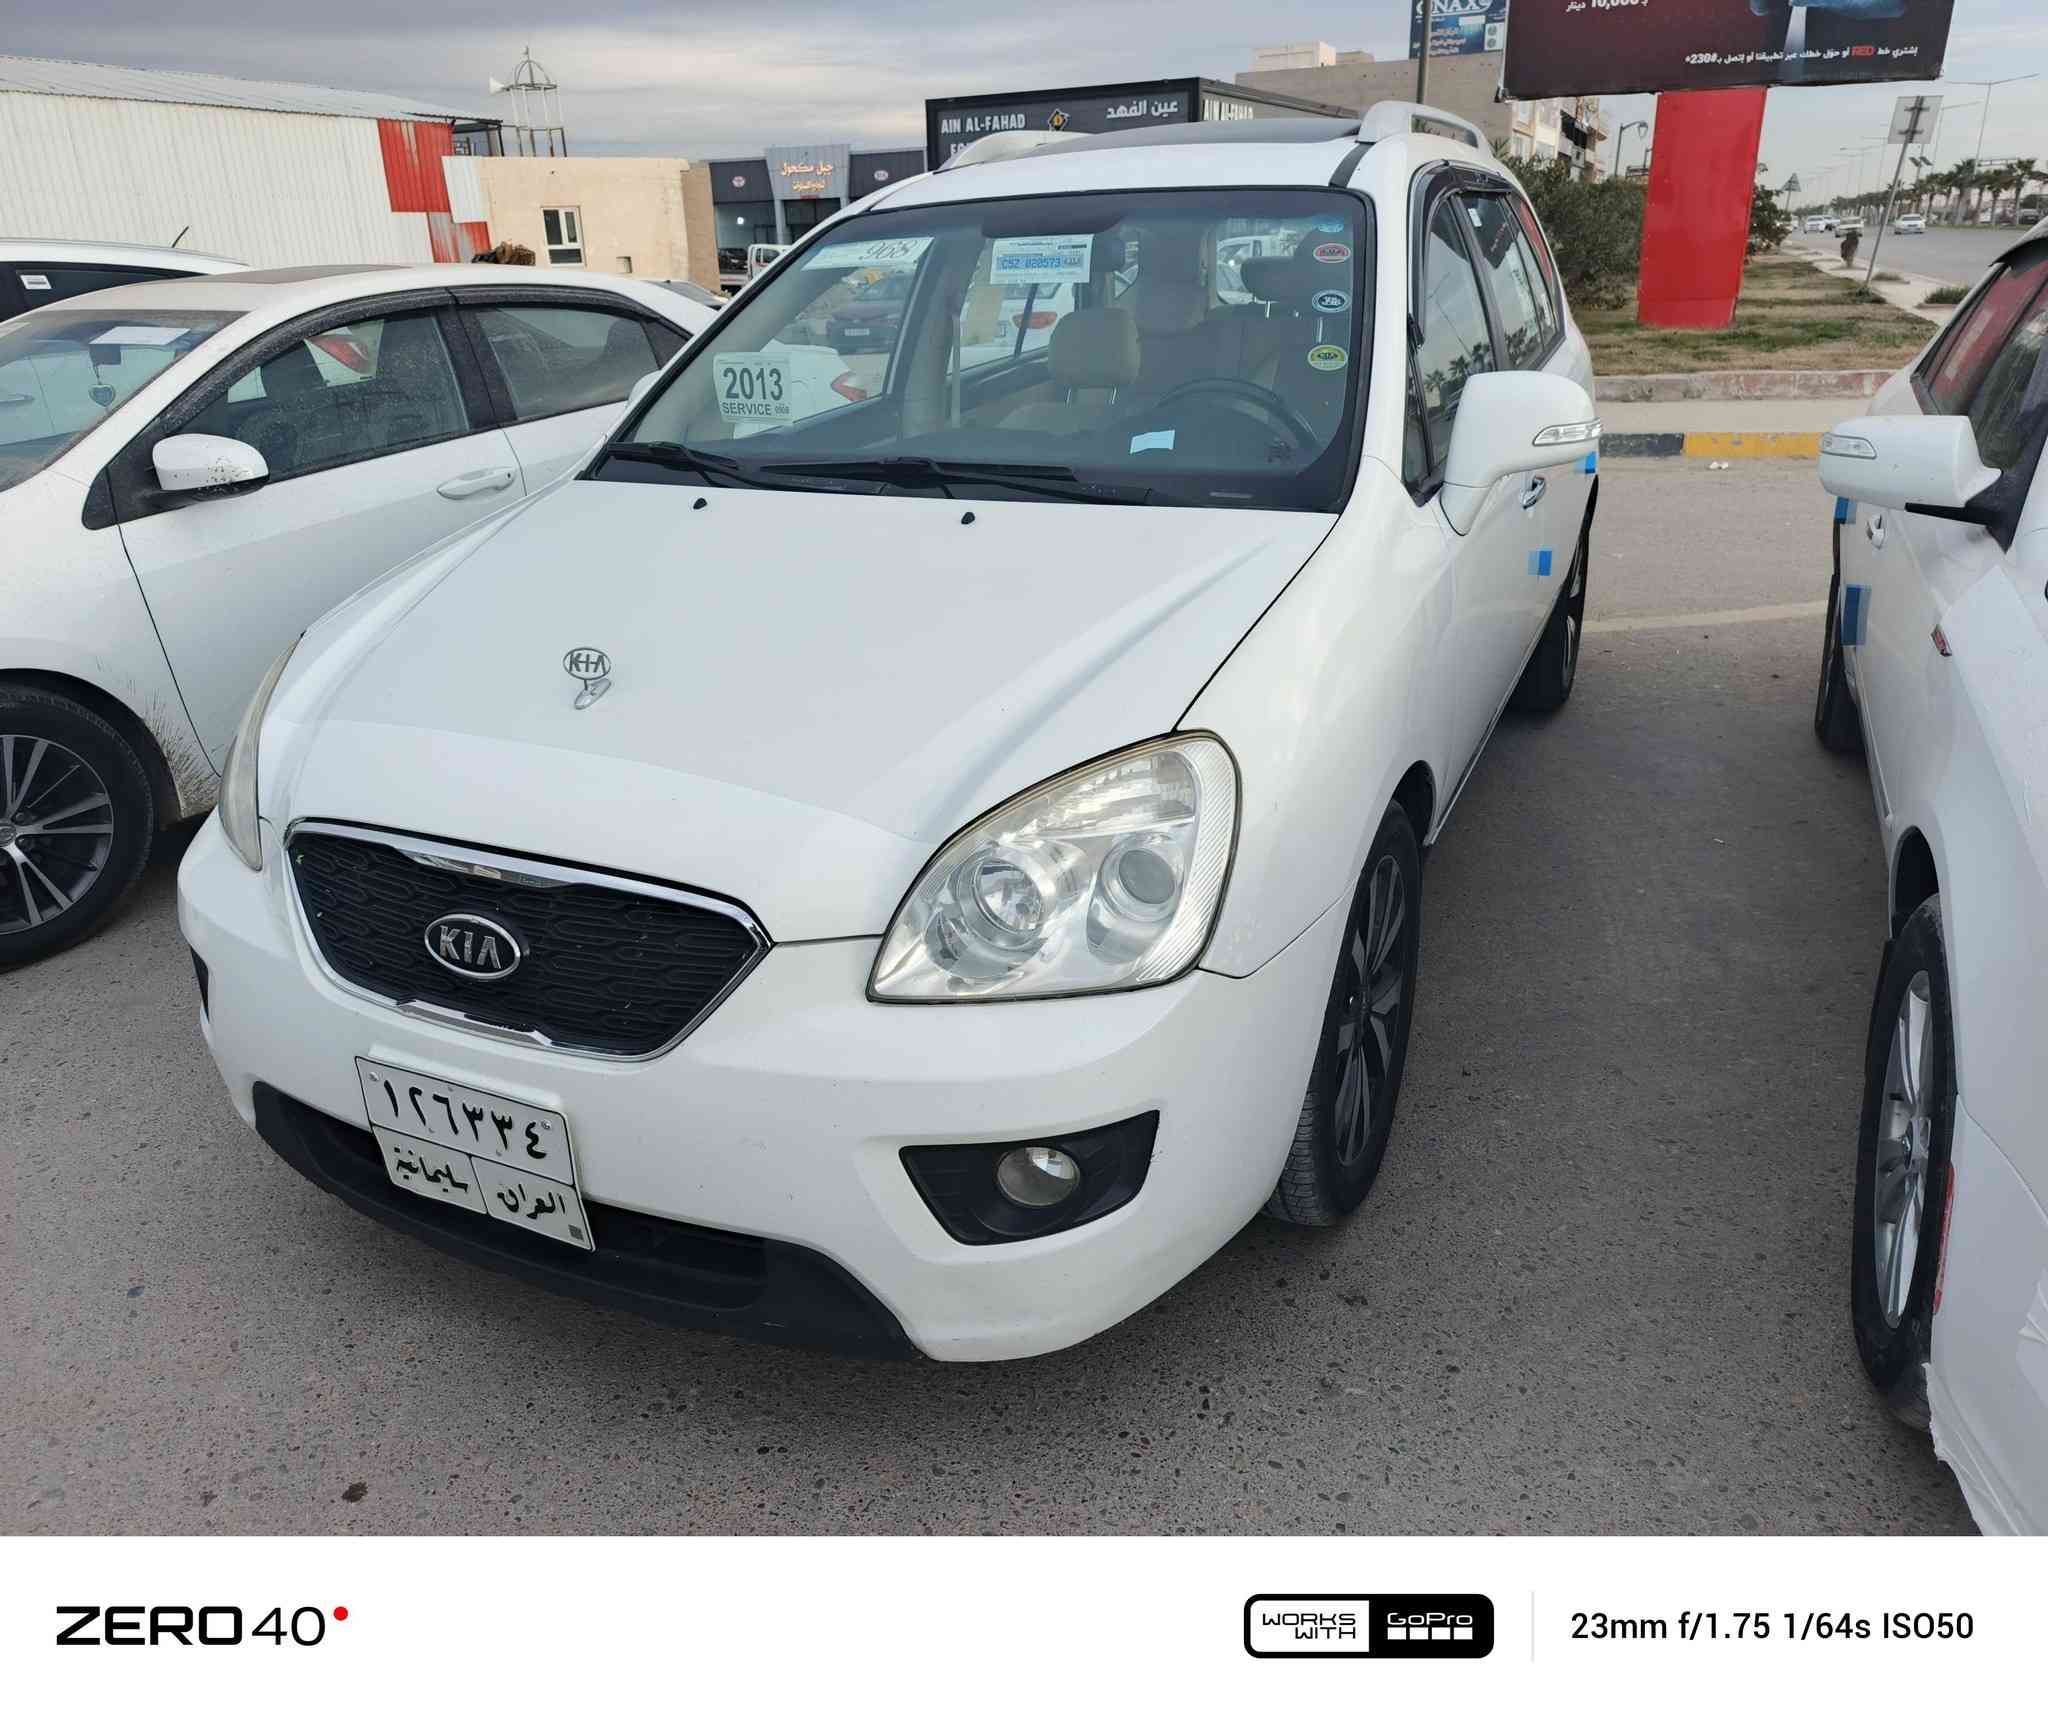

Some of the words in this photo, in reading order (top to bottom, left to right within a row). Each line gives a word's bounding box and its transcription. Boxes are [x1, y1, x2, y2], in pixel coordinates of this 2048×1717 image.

[1852, 46, 1875, 56] RED
[1106, 101, 1148, 119] الفهد
[1151, 100, 1179, 116] عين
[1203, 99, 1220, 121] AIN
[941, 118, 961, 134] AIN
[966, 113, 1026, 132] AL-FAHAD
[723, 367, 783, 401] 2013
[721, 402, 772, 416] SERVICE
[568, 652, 606, 674] KIA
[439, 924, 502, 970] KIA
[383, 1079, 548, 1160] ١٢٦٣٣٤
[497, 1183, 566, 1220] العراق
